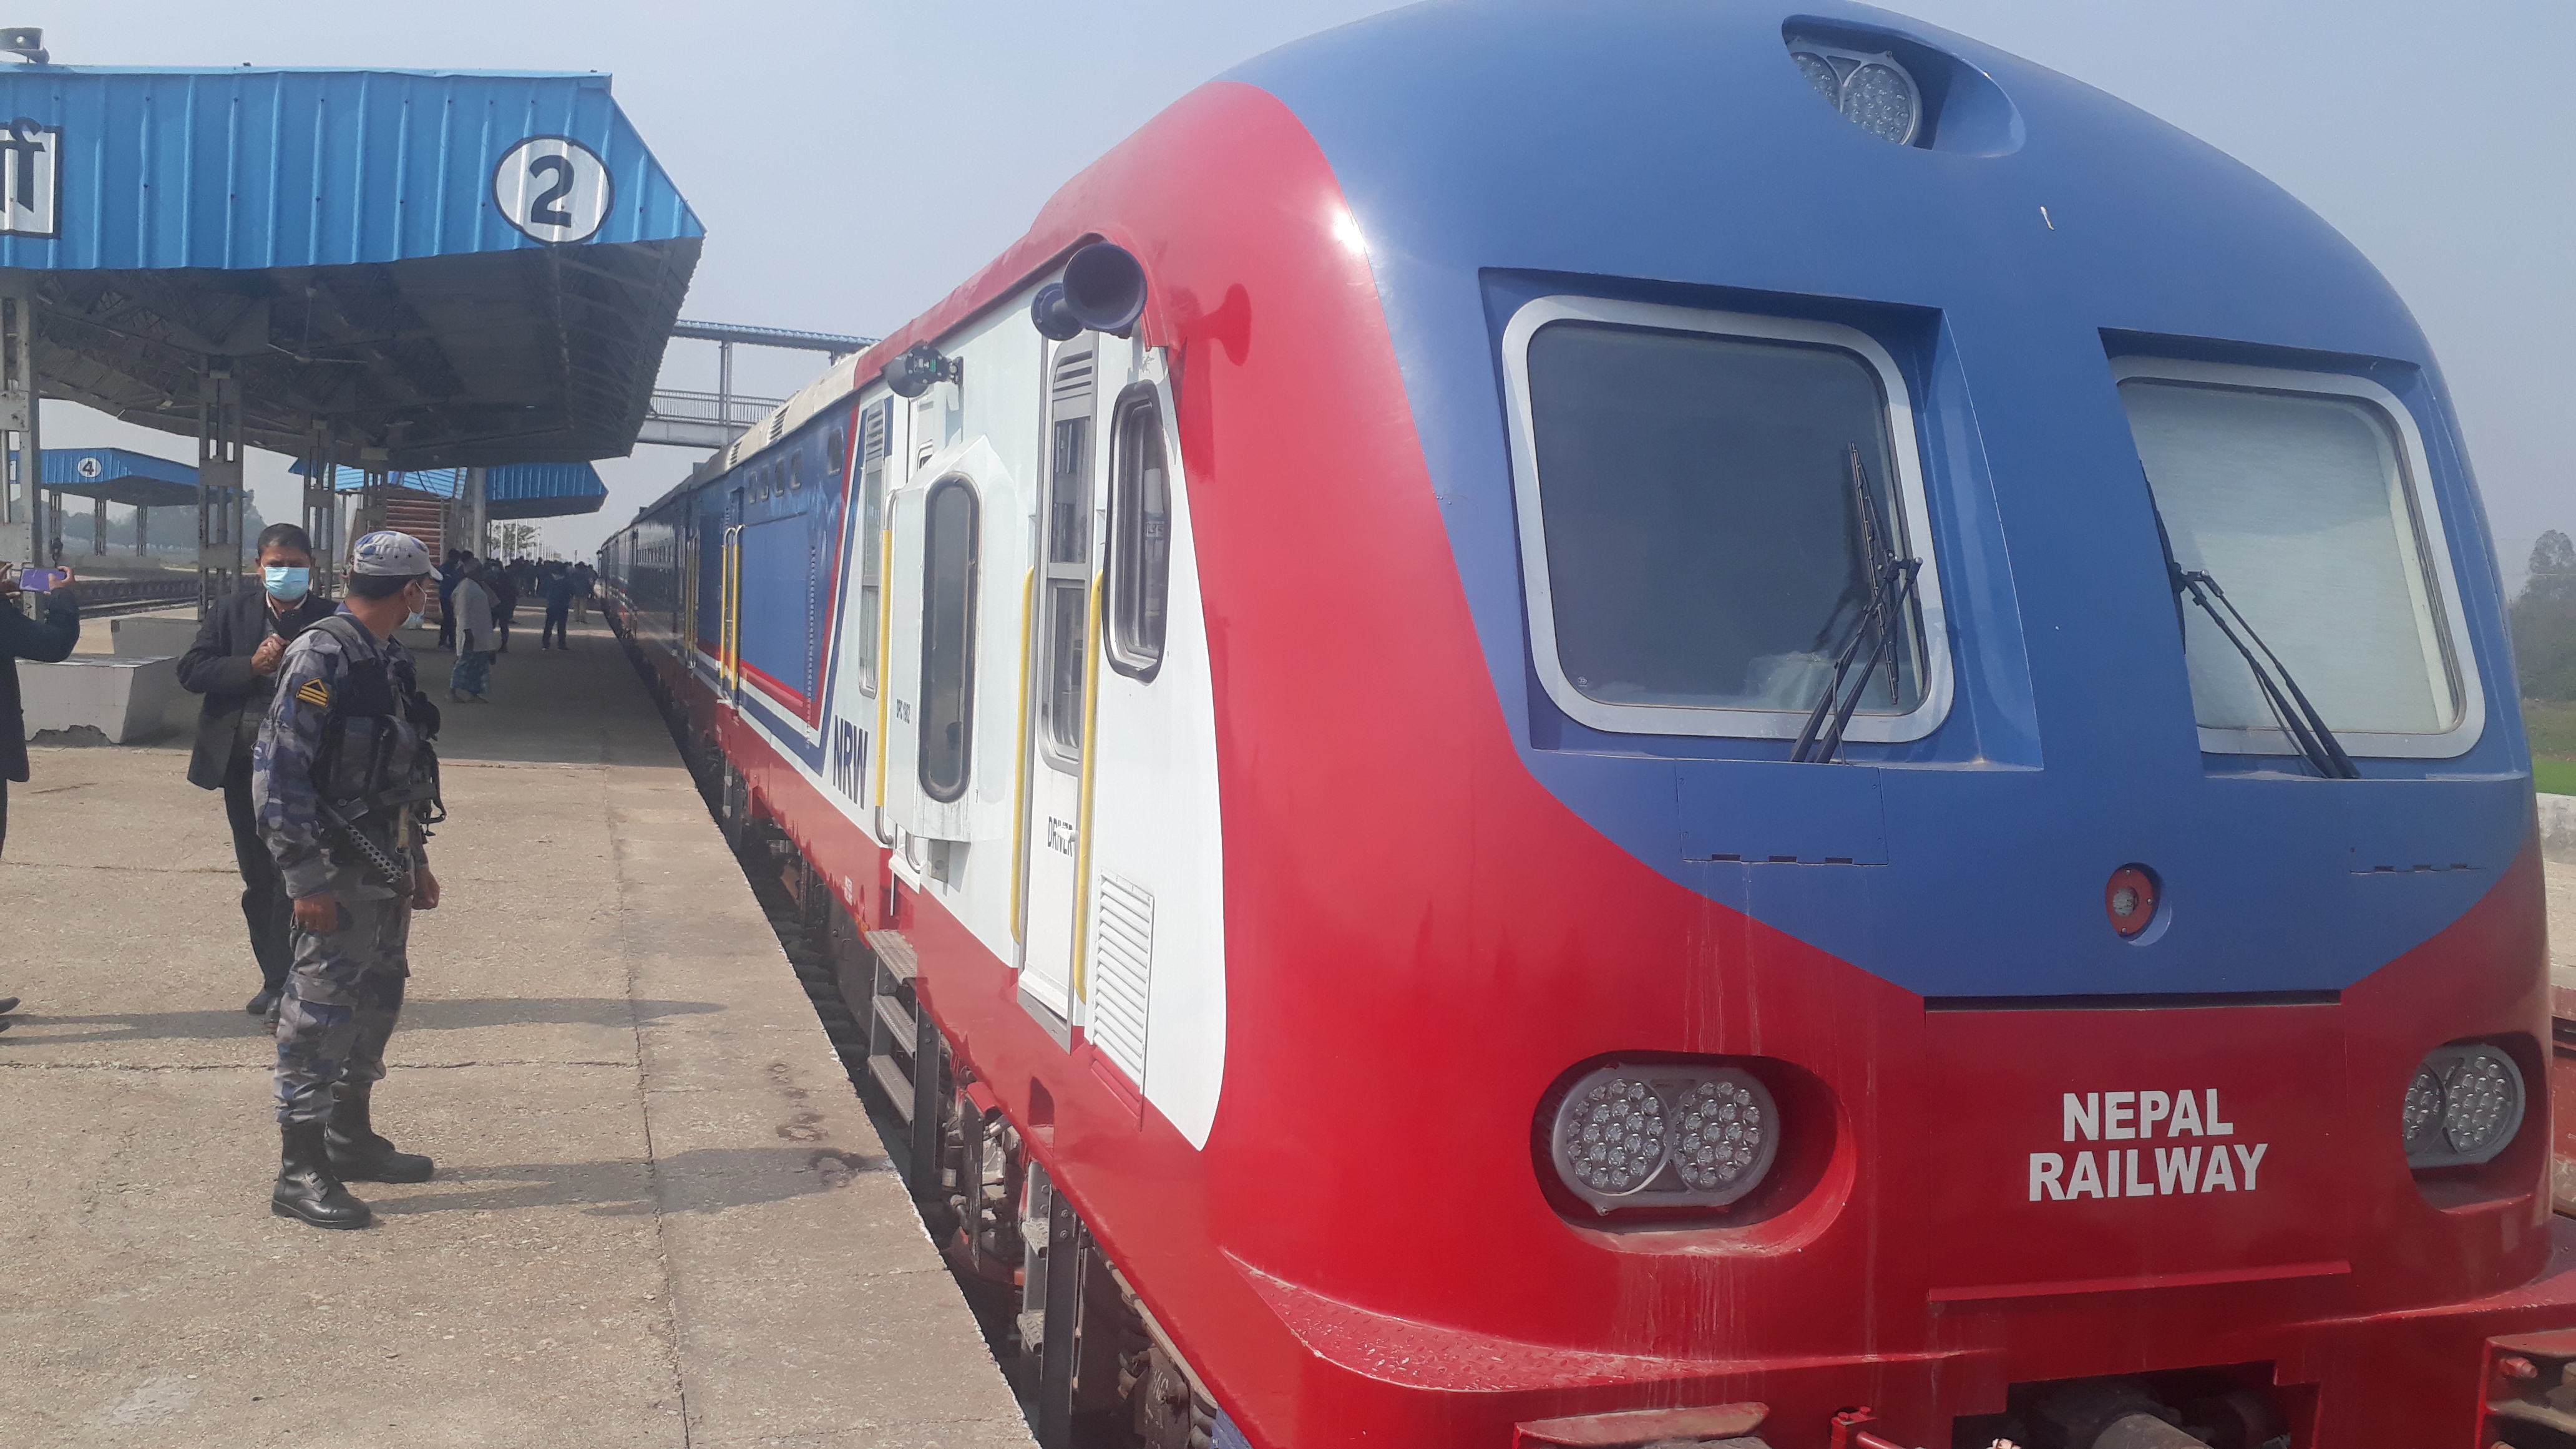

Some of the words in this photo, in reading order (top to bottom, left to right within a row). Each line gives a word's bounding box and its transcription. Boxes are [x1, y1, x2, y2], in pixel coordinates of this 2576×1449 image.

[529, 154, 575, 228] 2
[82, 461, 94, 476] 4
[832, 714, 869, 811] NRW
[2062, 1088, 2234, 1142] NEPAL
[2029, 1143, 2269, 1202] RAILWAY
